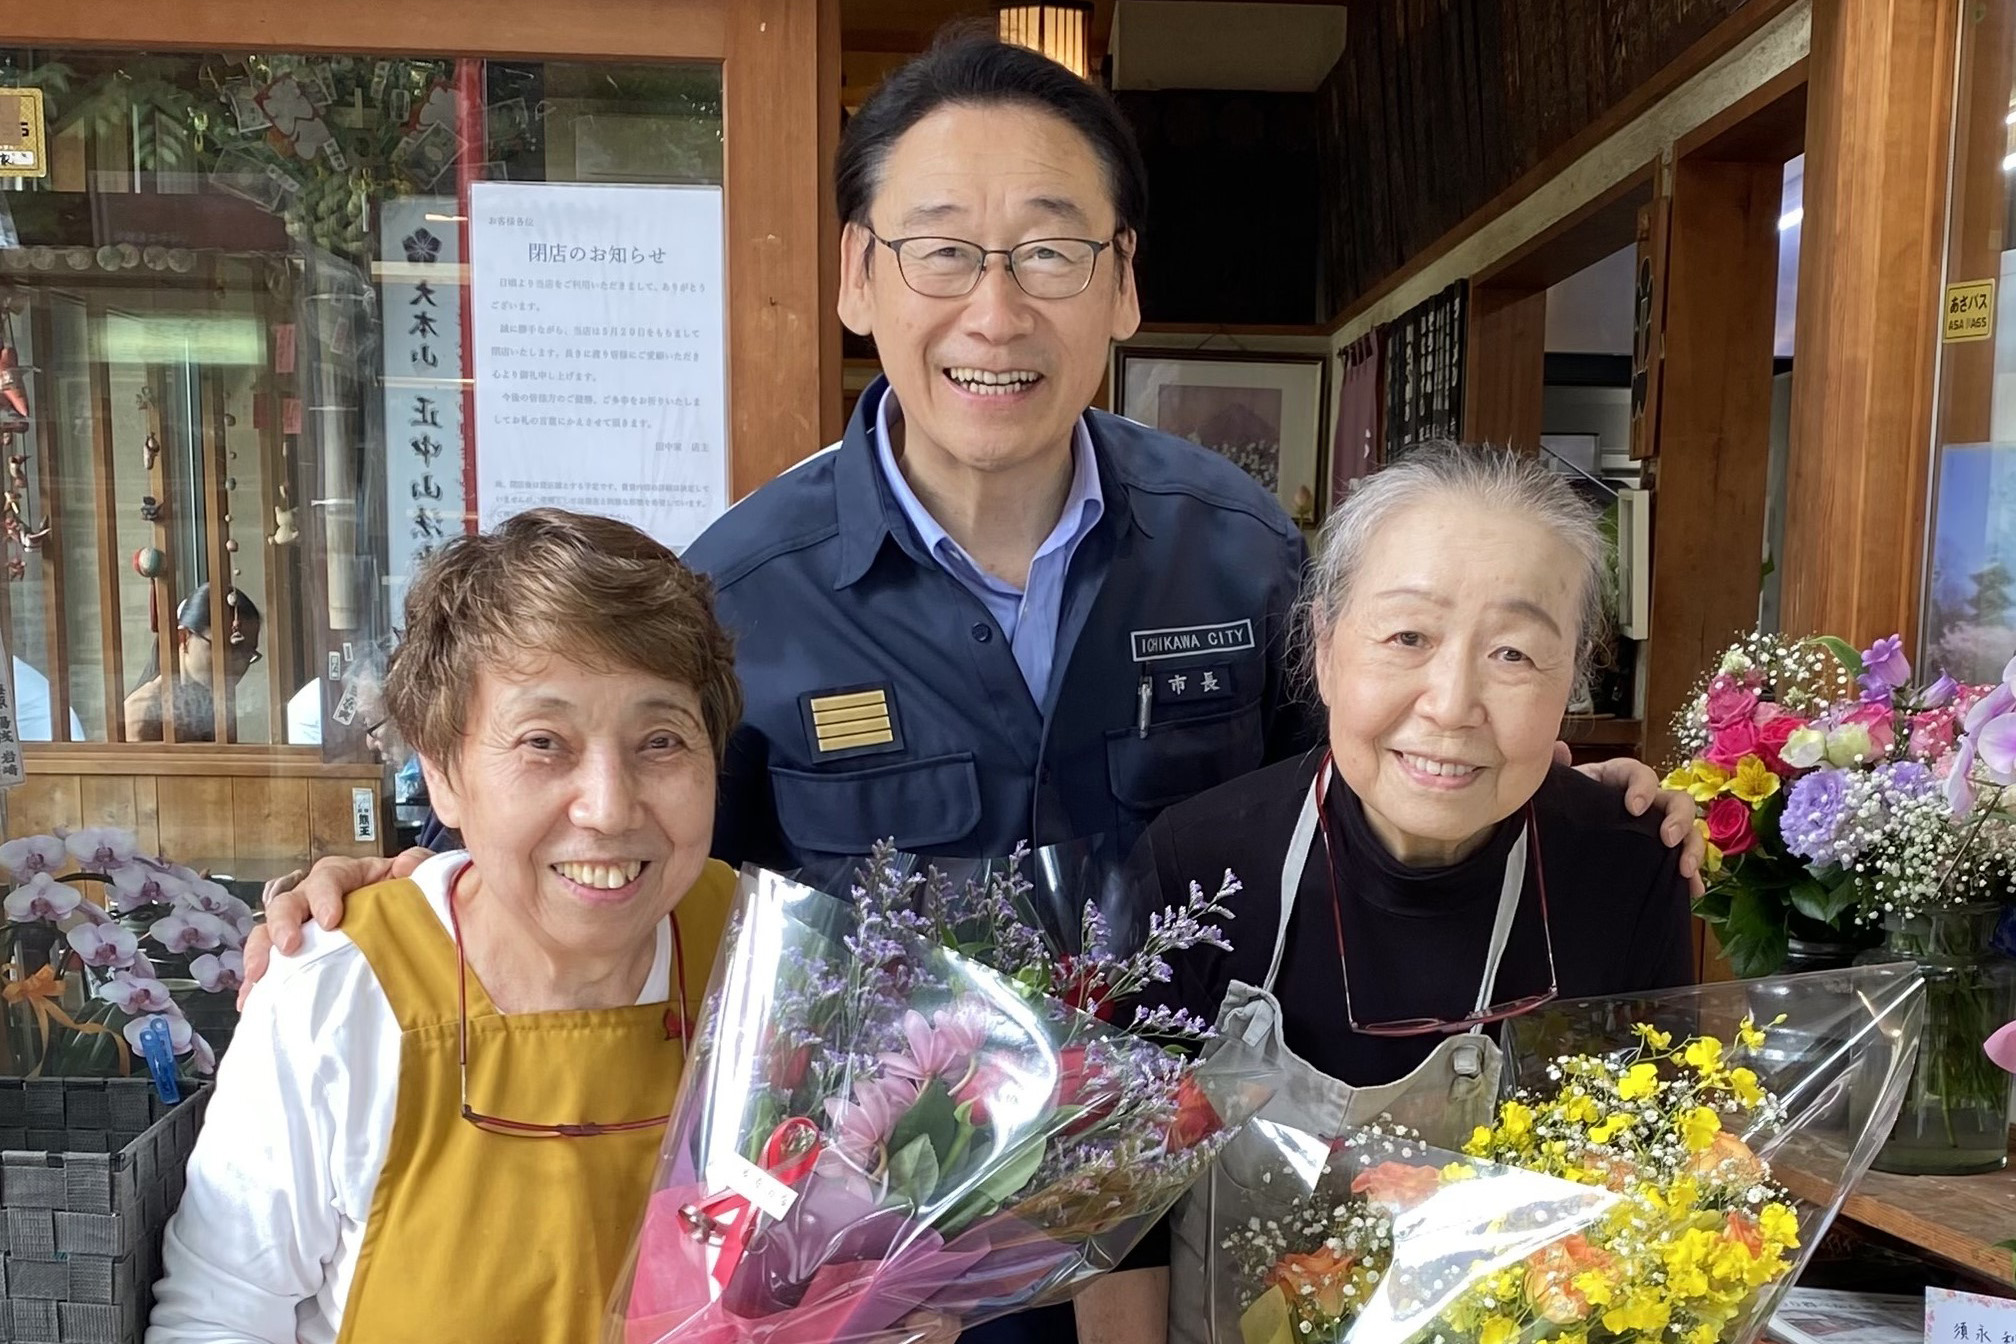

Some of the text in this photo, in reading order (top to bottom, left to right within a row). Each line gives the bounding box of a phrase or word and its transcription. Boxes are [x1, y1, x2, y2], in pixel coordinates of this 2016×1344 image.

[528, 242, 667, 264] 閉店のお知らせ
[1950, 293, 1988, 314] あさパス
[1948, 319, 1964, 331] ASA
[1142, 628, 1244, 653] ICHIKAWA CITY
[1168, 671, 1221, 695] 市長
